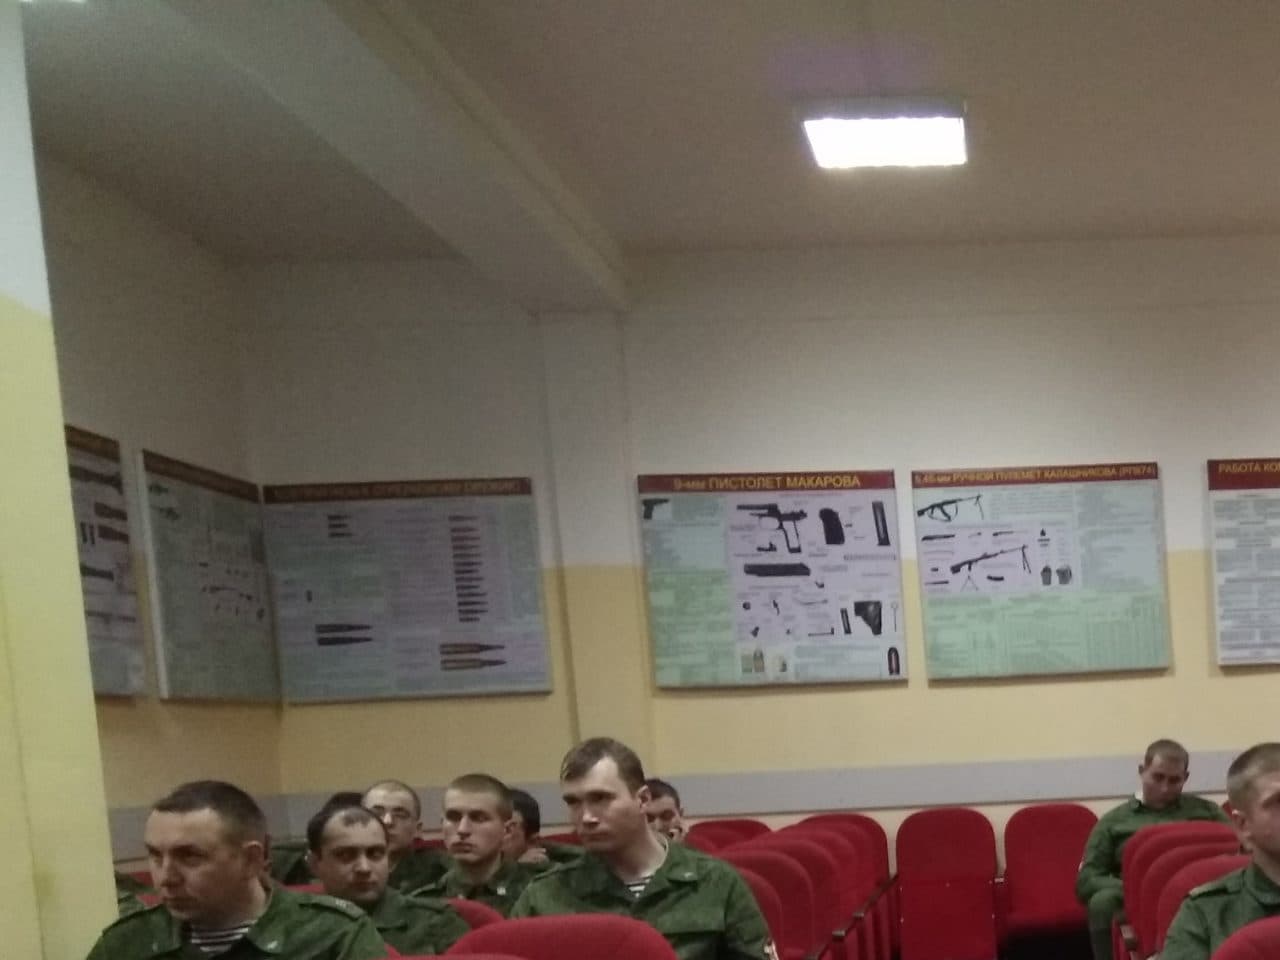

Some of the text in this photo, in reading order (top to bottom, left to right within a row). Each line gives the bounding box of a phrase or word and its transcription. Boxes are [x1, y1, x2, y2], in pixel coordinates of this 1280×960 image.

[1218, 462, 1261, 473] РАБОТА
[709, 476, 783, 489] ПИСТОЛЕТ
[786, 475, 861, 489] МАКАРОВА
